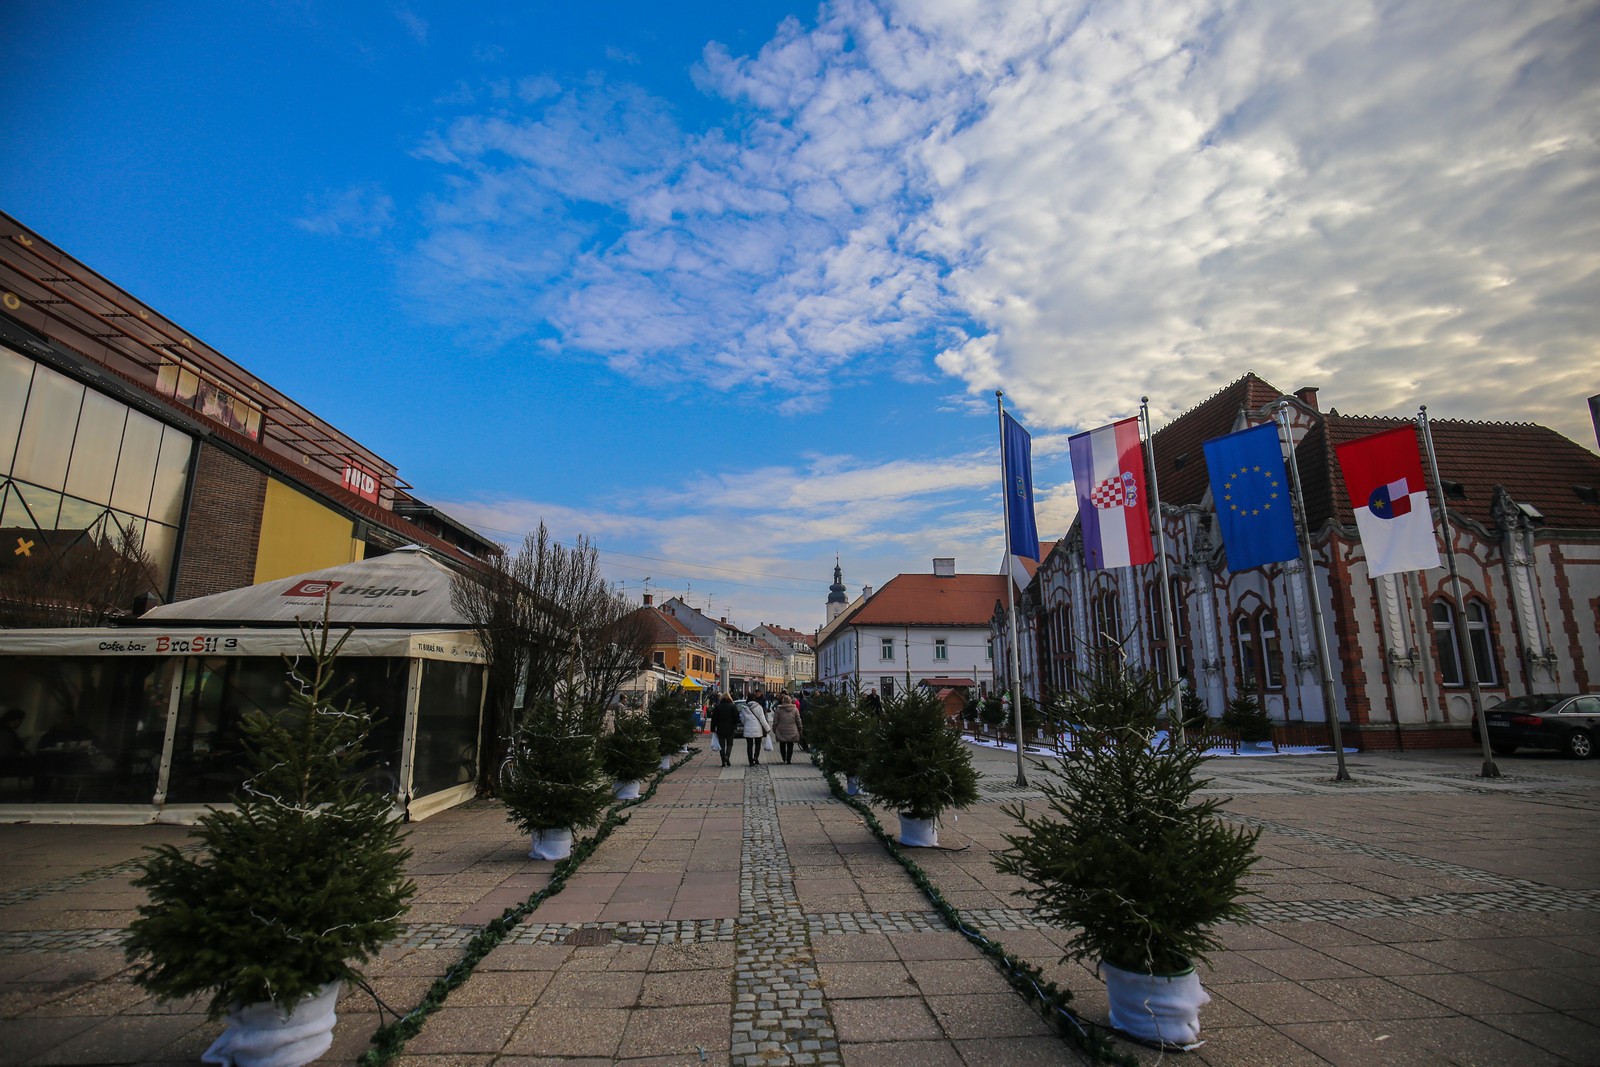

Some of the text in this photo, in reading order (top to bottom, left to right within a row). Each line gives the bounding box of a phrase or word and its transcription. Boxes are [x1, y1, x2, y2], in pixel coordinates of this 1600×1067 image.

[345, 464, 375, 494] NKD
[338, 585, 428, 599] triglav
[127, 640, 147, 652] bar
[155, 636, 219, 653] BraSil
[224, 638, 238, 648] 3
